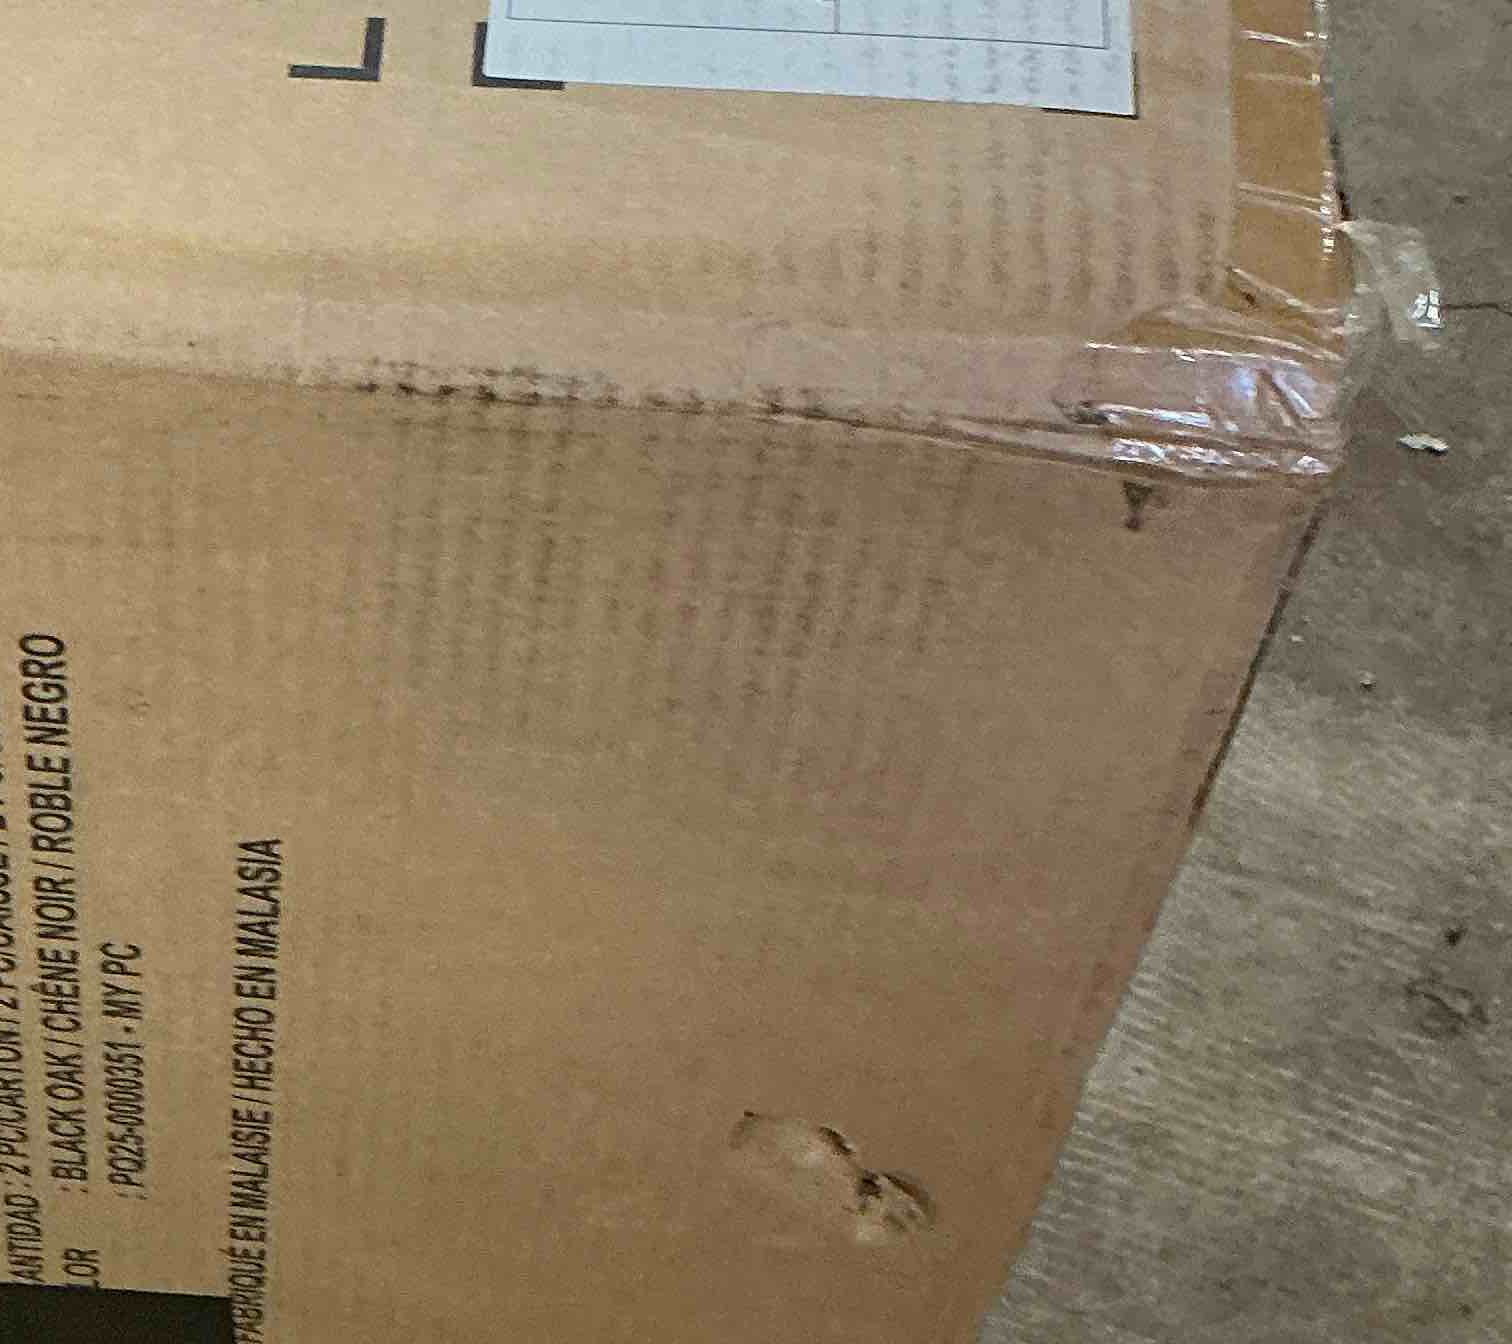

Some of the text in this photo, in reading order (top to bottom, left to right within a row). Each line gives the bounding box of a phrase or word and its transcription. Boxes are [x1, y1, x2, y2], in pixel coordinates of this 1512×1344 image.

[18, 632, 70, 748] NEGRO
[24, 755, 73, 854] ROBLE
[32, 876, 78, 942] NOIR
[233, 838, 284, 960] MALASIA
[28, 948, 83, 1034] CHÊNE
[98, 942, 142, 978] PC
[100, 982, 144, 1022] MY
[234, 965, 279, 1002] EN
[42, 1051, 86, 1101] OAK
[232, 1008, 278, 1093] HECHO
[44, 1108, 89, 1182] BLACK
[228, 1108, 274, 1212] MALAISIE
[3, 1192, 45, 1284] ANTIDAD
[227, 1214, 270, 1244] EN
[217, 1246, 268, 1344] FABRIQUÉ
